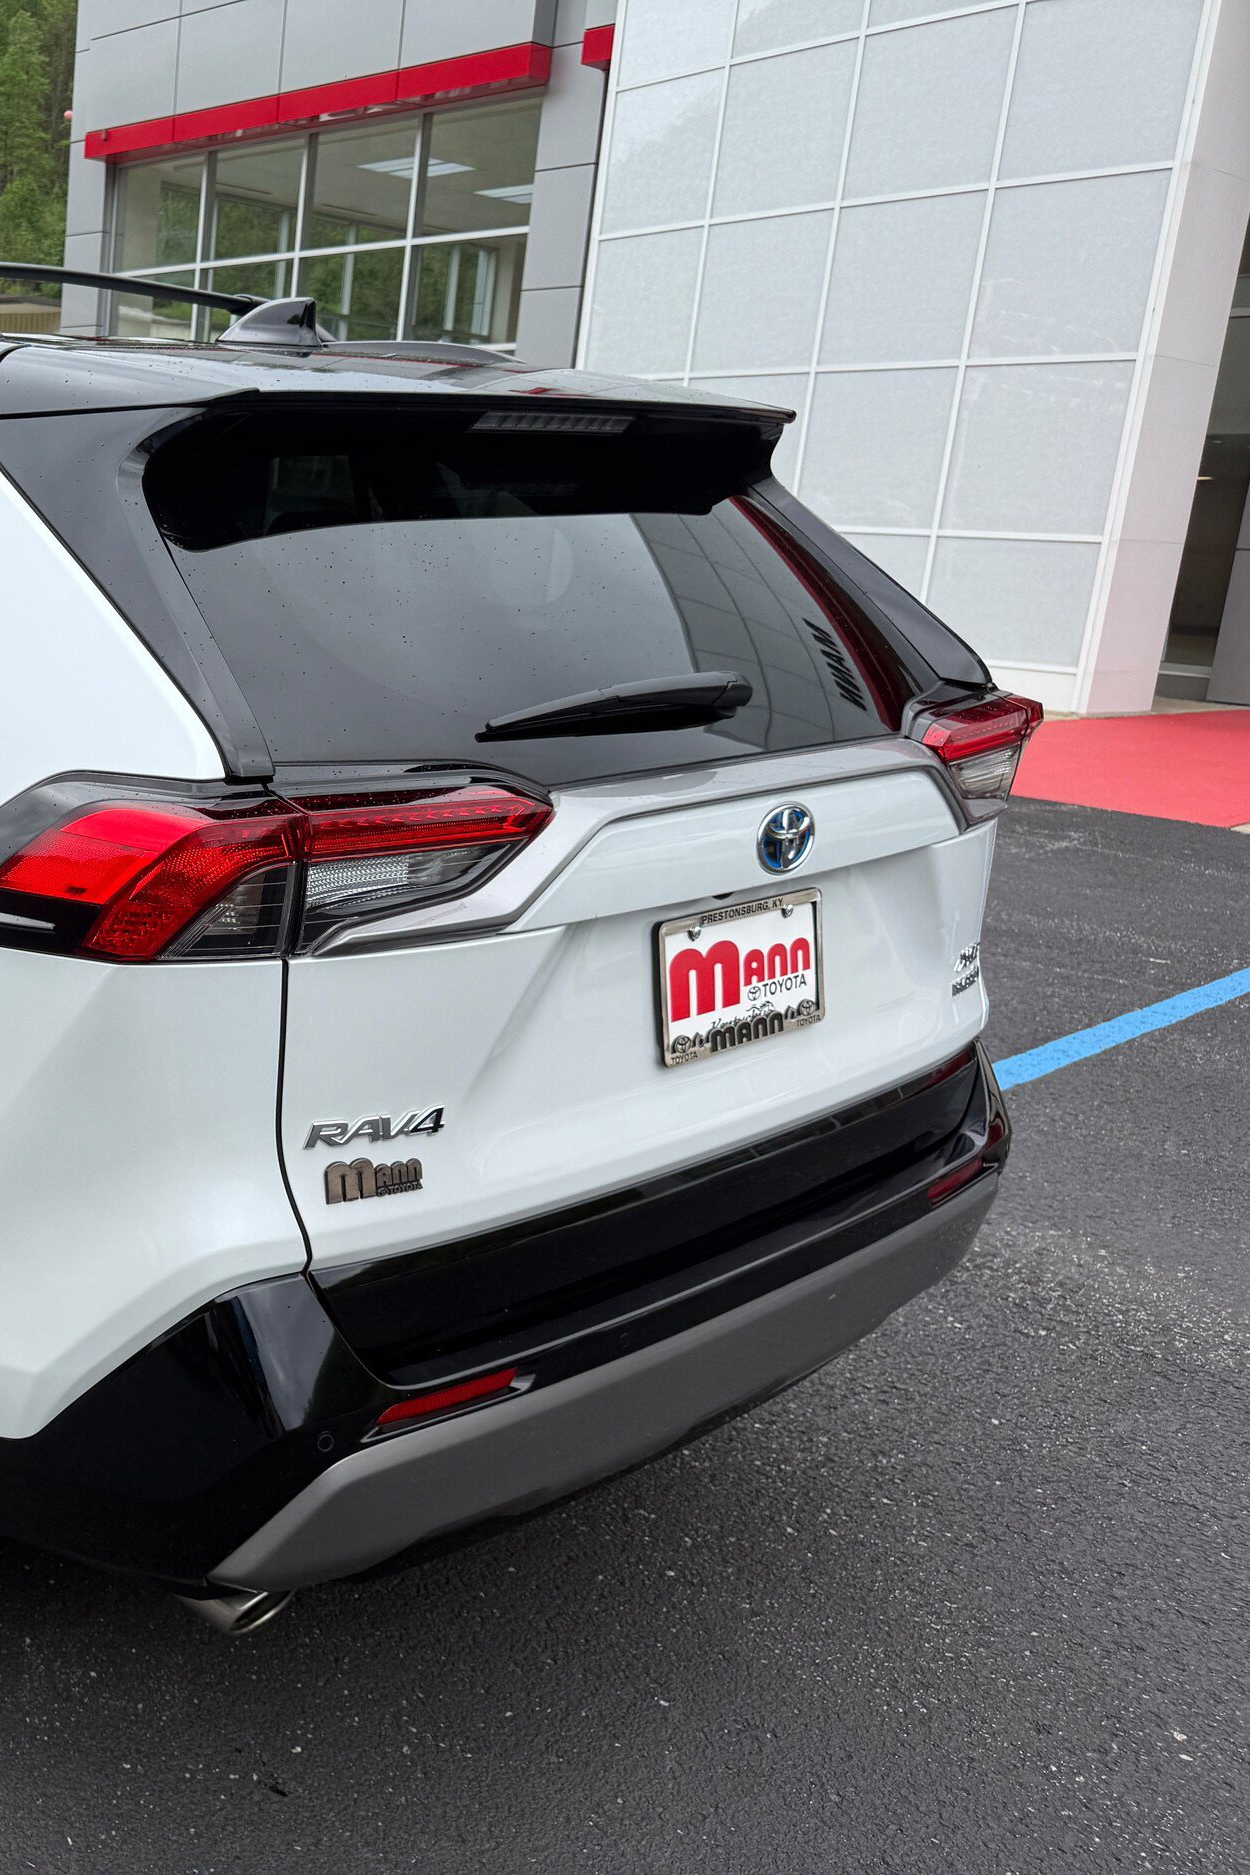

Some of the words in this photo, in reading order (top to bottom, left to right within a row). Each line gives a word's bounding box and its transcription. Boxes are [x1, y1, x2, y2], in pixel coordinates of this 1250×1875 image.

[700, 901, 770, 925] PRESTONSBURG,
[772, 898, 784, 909] KY
[763, 974, 807, 998] TOYOTA
[796, 1014, 821, 1028] TOYOTA
[670, 1051, 698, 1065] TOYOTA
[302, 1104, 445, 1150] RAV4
[388, 1181, 424, 1196] TOYOTA
